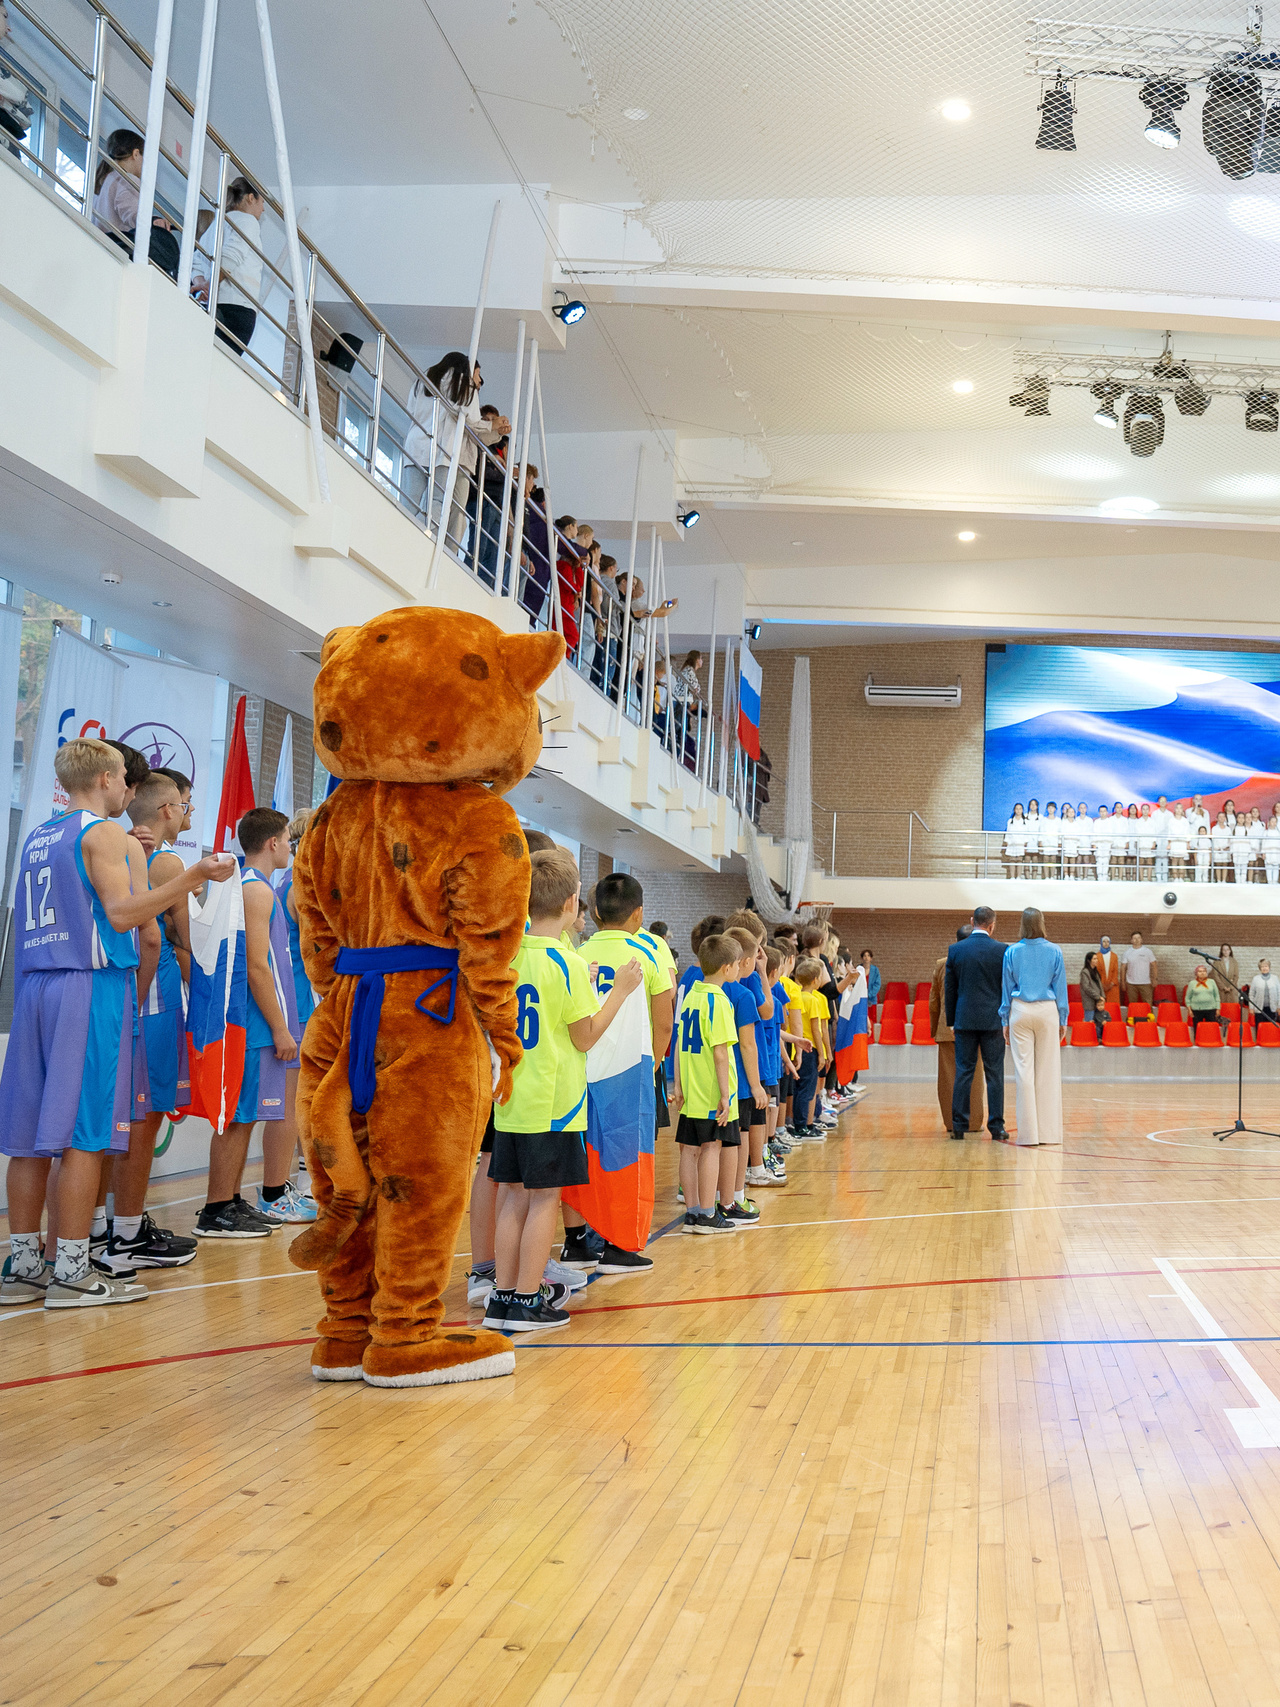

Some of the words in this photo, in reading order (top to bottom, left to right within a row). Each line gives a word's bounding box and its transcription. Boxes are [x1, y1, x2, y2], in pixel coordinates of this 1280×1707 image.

[29, 846, 49, 864] КРАЙ
[173, 840, 197, 848] ВЕННОЙ
[24, 865, 56, 932] 12
[515, 983, 540, 1050] 6
[680, 1007, 704, 1055] 14
